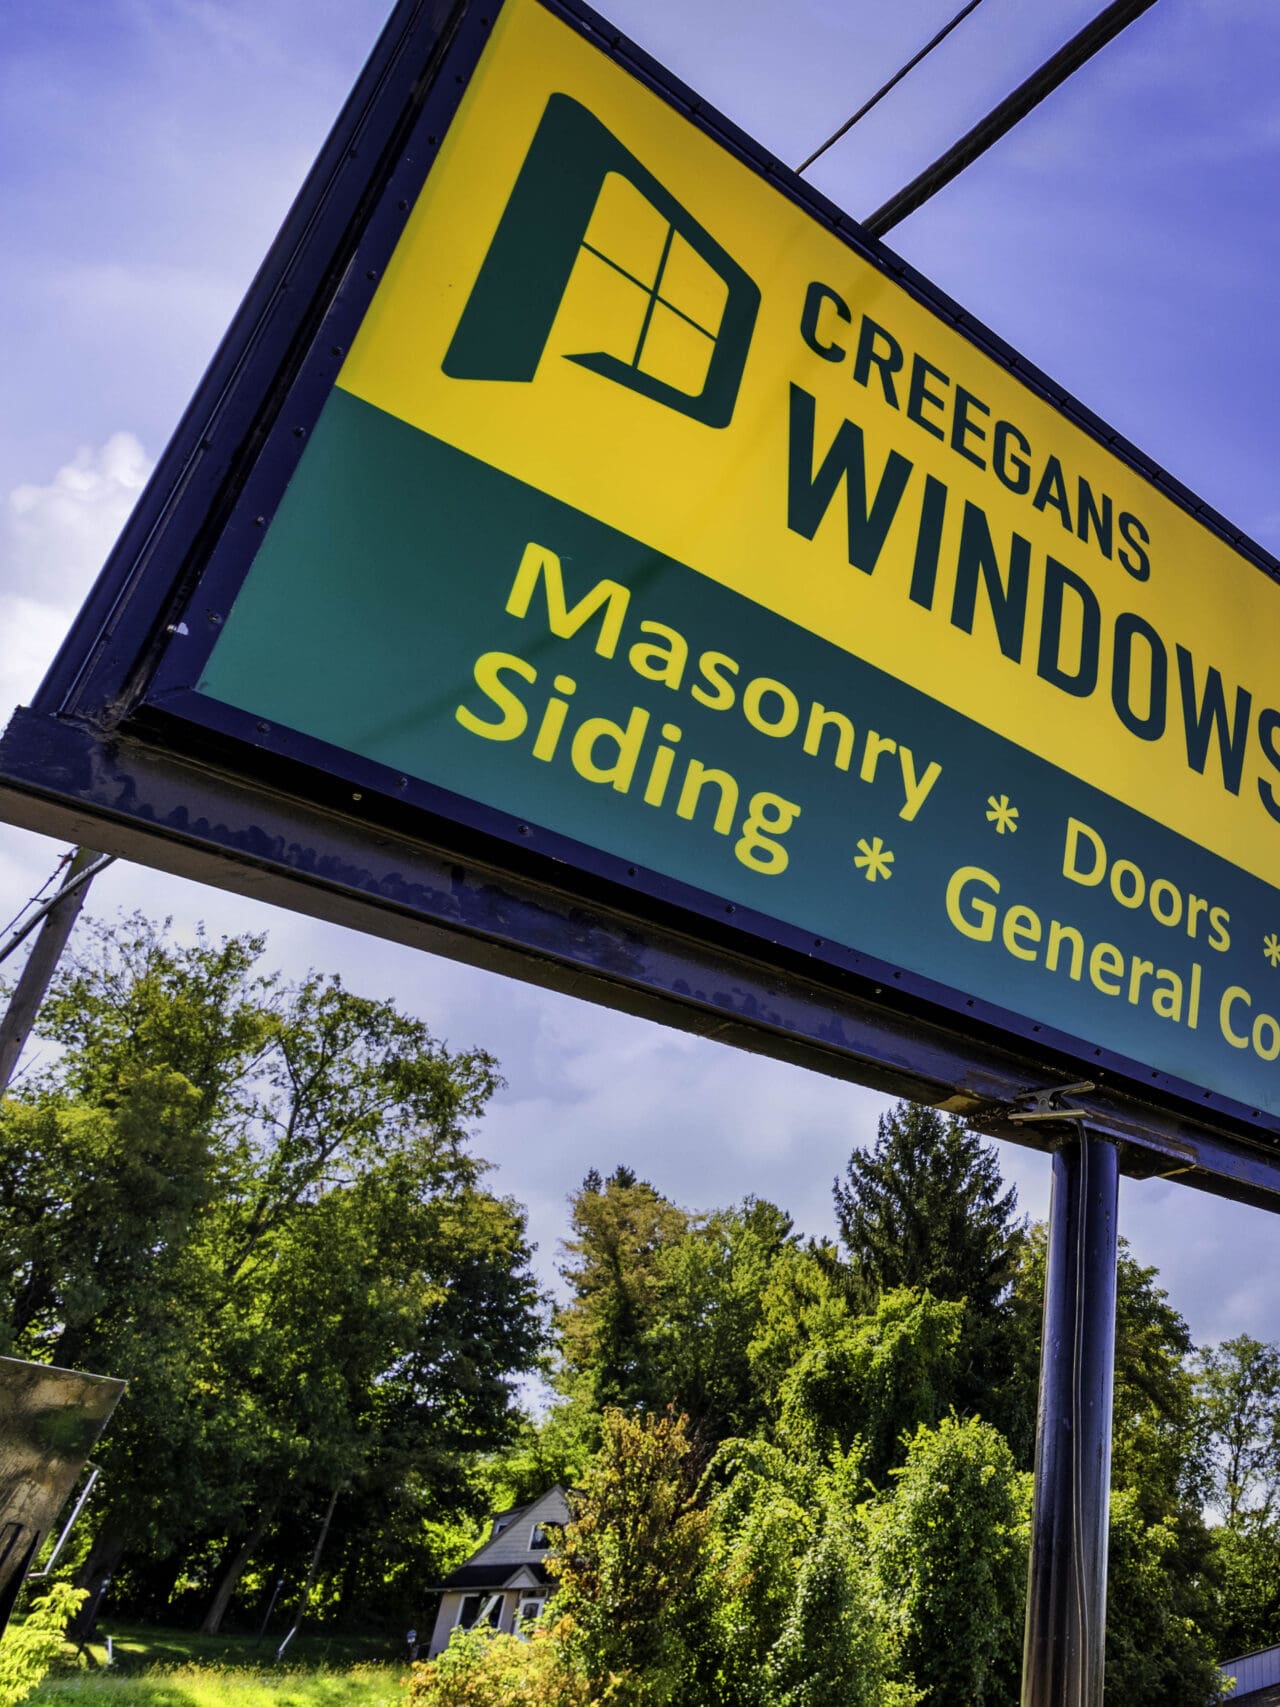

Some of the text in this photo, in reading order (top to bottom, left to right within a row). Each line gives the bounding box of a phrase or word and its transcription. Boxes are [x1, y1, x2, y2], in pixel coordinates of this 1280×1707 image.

[801, 281, 1150, 584] CREEGANS
[455, 651, 802, 875] Siding
[945, 866, 1202, 1030] General
[505, 542, 942, 822] Masonry
[1062, 816, 1231, 953] Doors
